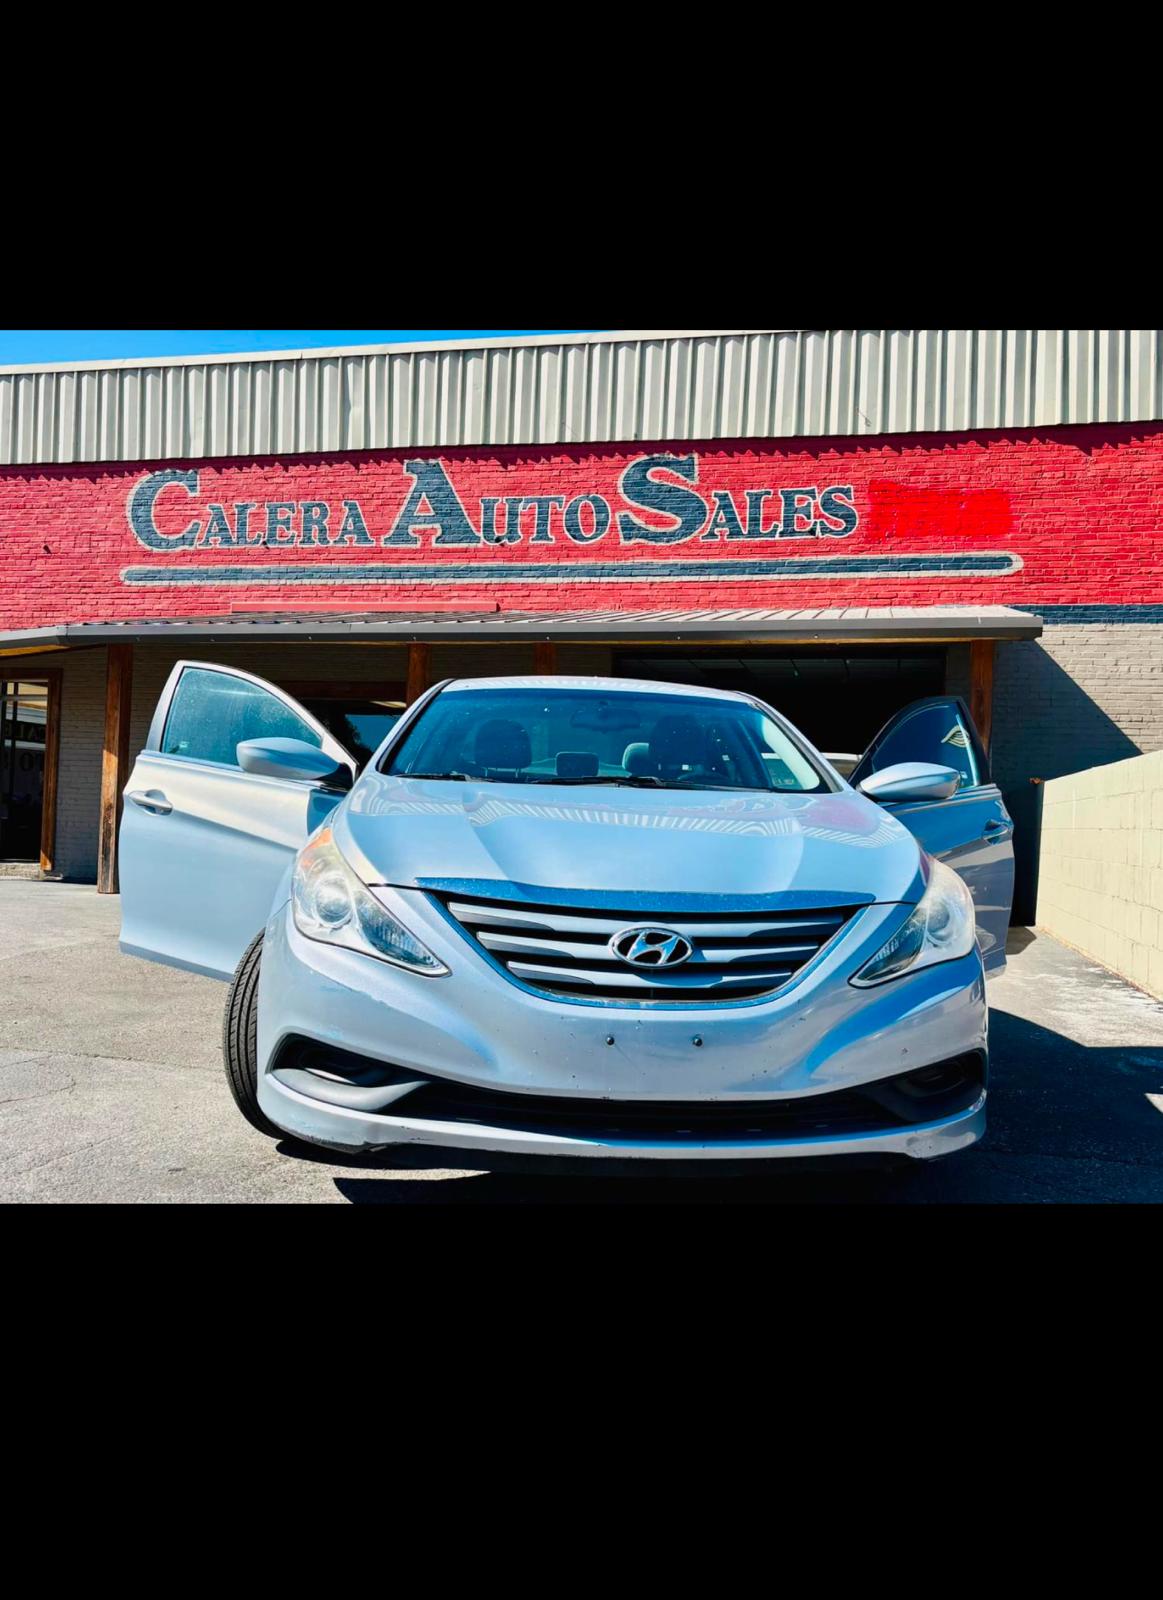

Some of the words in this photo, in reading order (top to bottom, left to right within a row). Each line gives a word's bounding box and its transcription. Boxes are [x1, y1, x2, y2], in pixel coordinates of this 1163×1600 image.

[126, 468, 375, 551] CALERA
[381, 457, 611, 548] AUTO
[617, 453, 859, 546] SALES
